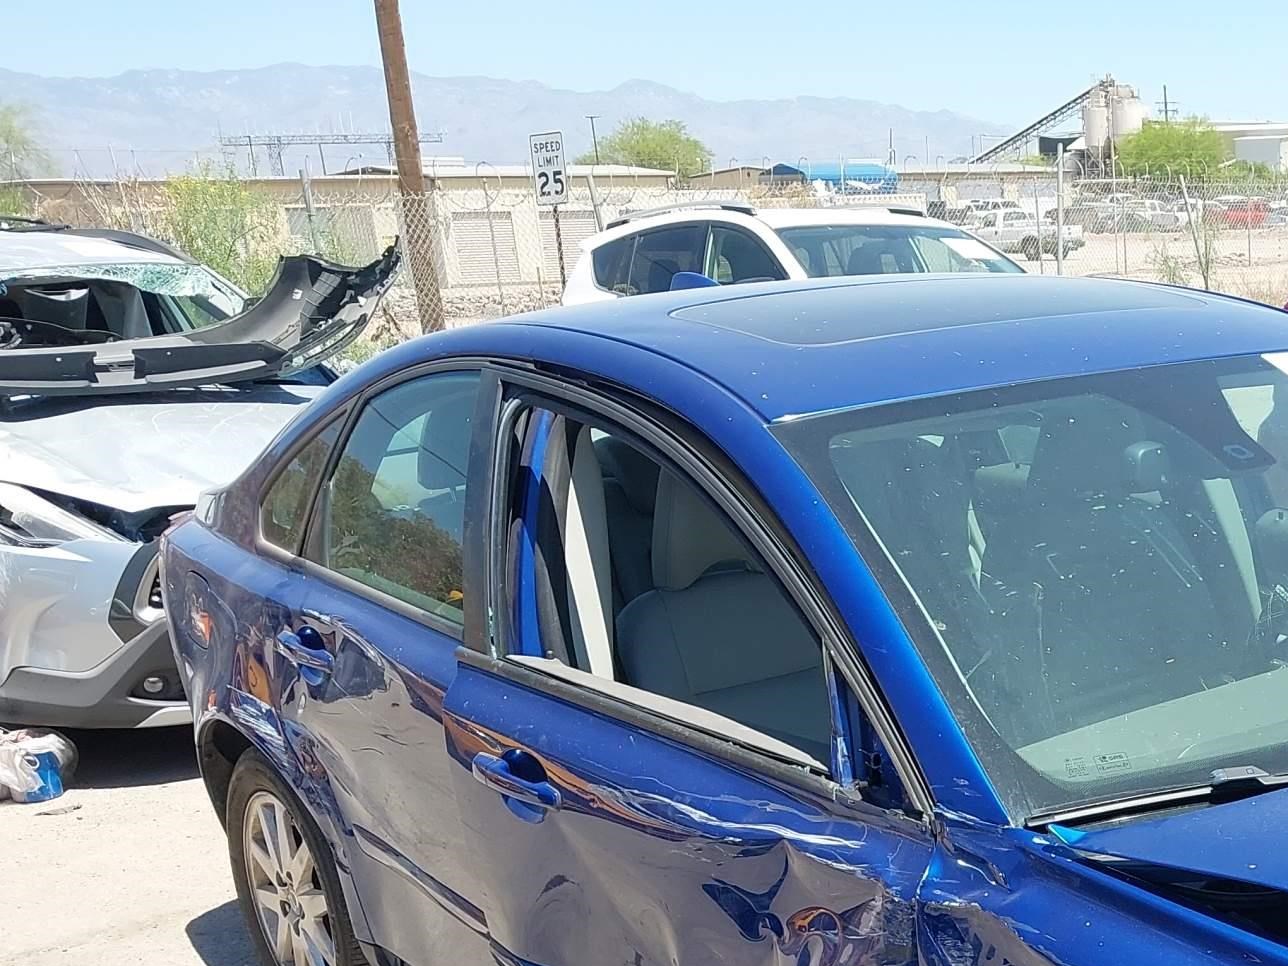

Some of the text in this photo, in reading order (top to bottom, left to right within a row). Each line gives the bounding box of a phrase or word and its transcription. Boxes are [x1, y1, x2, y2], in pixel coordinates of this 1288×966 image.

[533, 141, 561, 153] SPEED
[537, 155, 559, 168] LIMIT
[538, 170, 565, 197] 25
